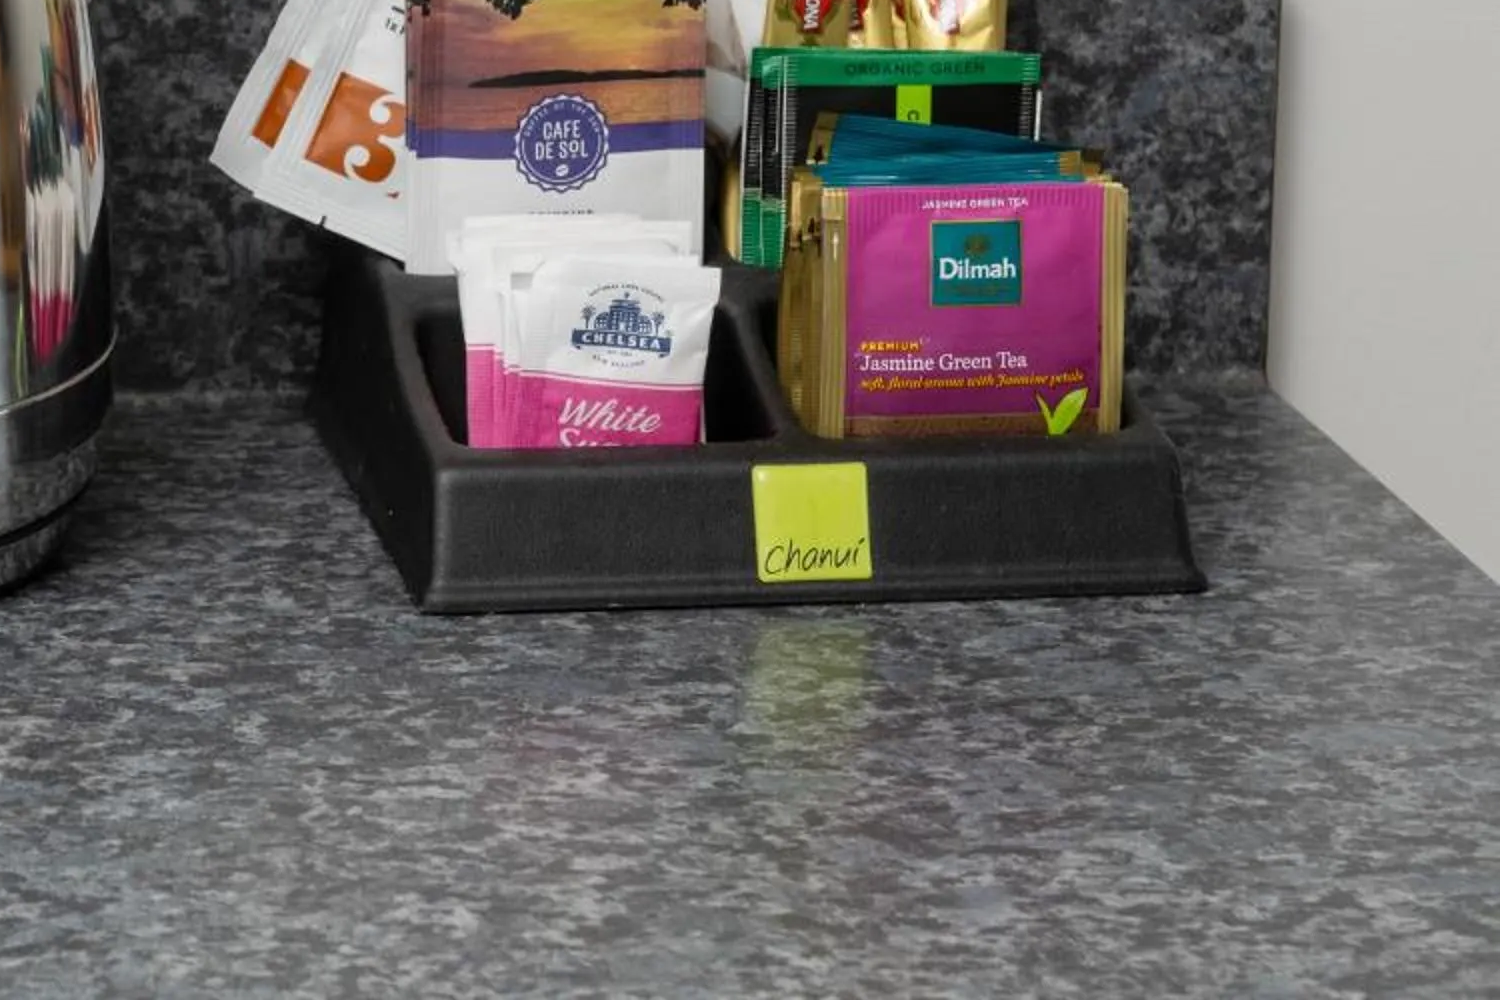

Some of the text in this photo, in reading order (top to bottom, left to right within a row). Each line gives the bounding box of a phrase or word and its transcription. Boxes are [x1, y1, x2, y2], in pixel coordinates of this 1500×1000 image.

[844, 60, 986, 77] ORGANIC GREEN
[543, 119, 581, 140] CAFE
[535, 141, 555, 160] DE
[939, 257, 1017, 280] Dilmah
[581, 332, 661, 350] CHELSEA
[861, 341, 919, 352] PREMIUM
[860, 351, 1028, 371] Jasmine Green Tea
[558, 397, 661, 433] White
[764, 538, 865, 575] Chanui
